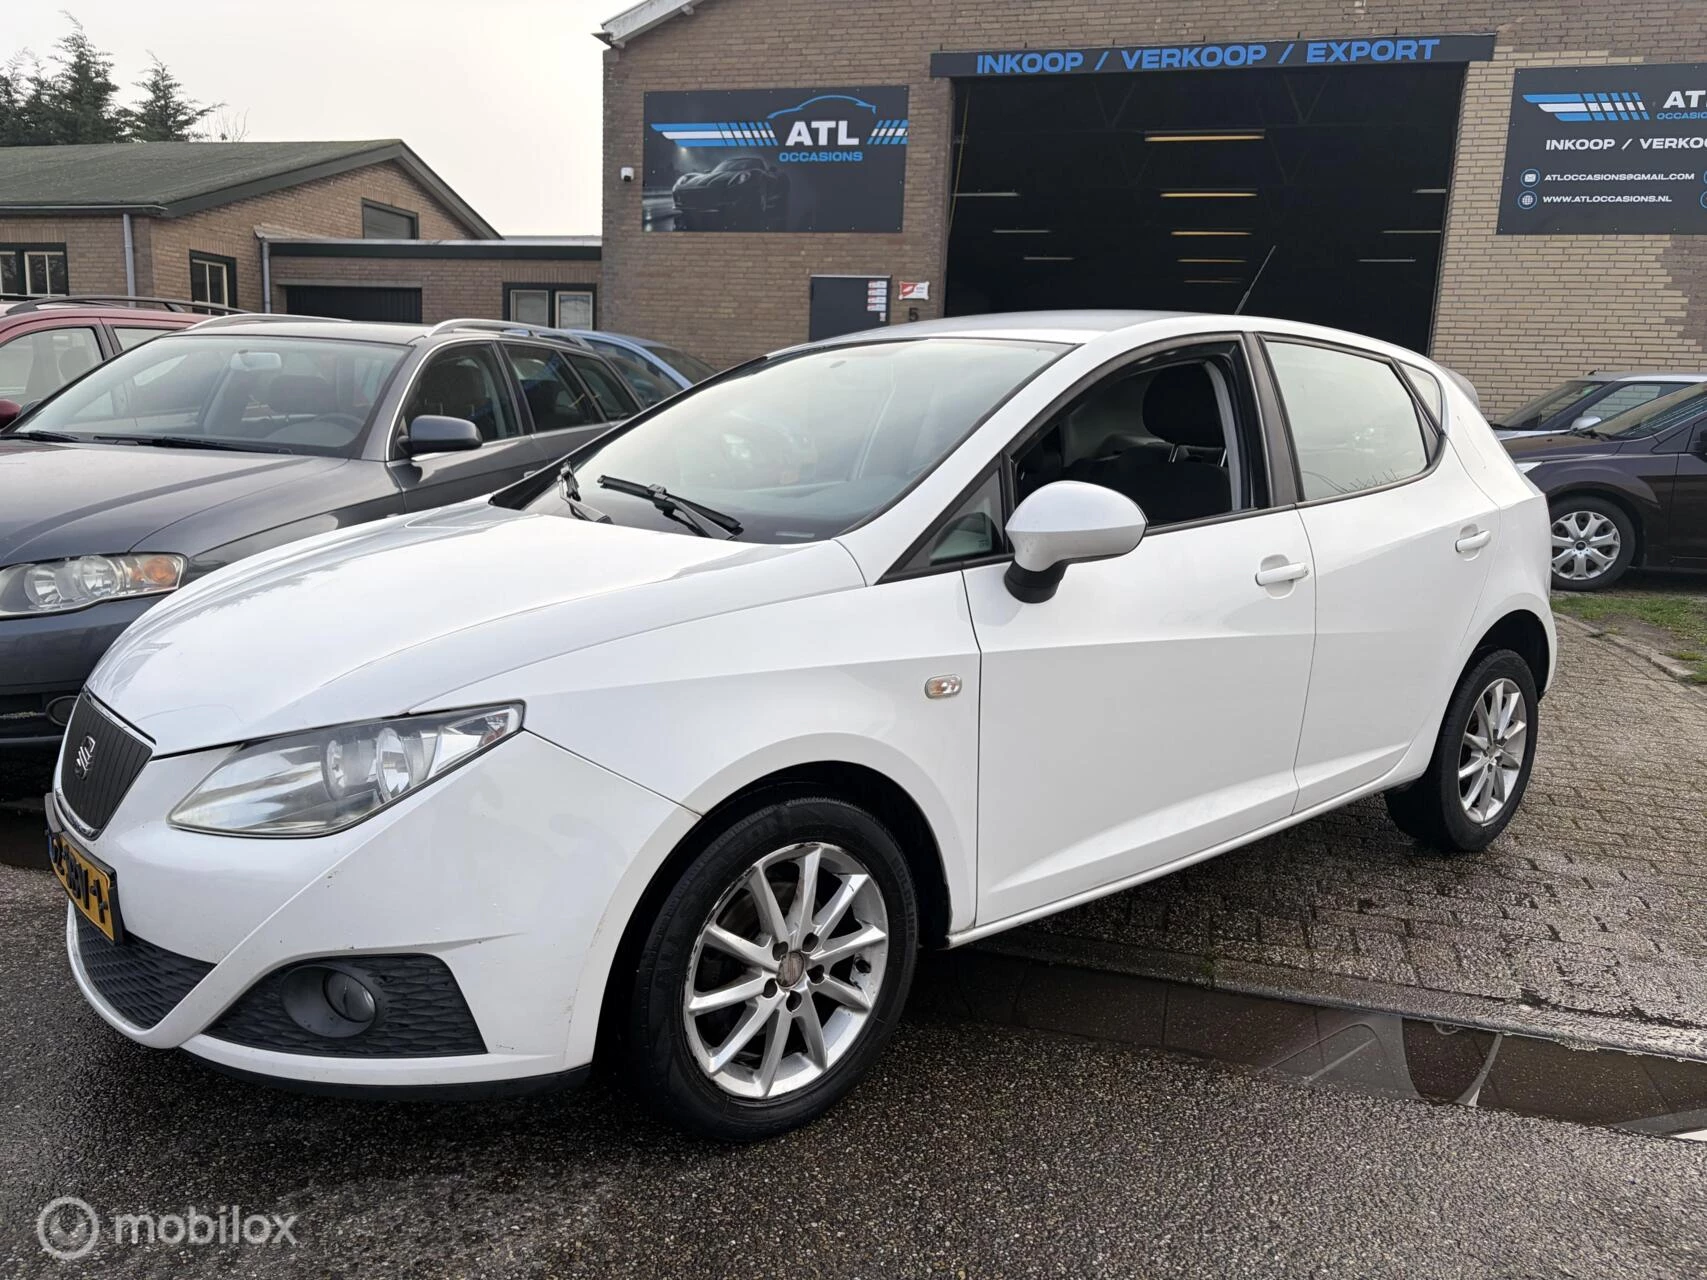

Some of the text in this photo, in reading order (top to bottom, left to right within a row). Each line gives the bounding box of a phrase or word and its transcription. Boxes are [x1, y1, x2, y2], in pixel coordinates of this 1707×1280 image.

[976, 39, 1440, 74] INKOOP / VERKOOP / EXPORT
[1662, 90, 1707, 109] AT
[785, 120, 859, 146] ATL
[1545, 137, 1707, 151] INKOOP / VERKO
[779, 151, 863, 162] OCCASIONS
[1544, 173, 1695, 181] ATLOCCASIONS@GMAIL.COM
[1542, 195, 1673, 203] WWW.ATLOCCASIONS.NL
[908, 307, 919, 321] 5
